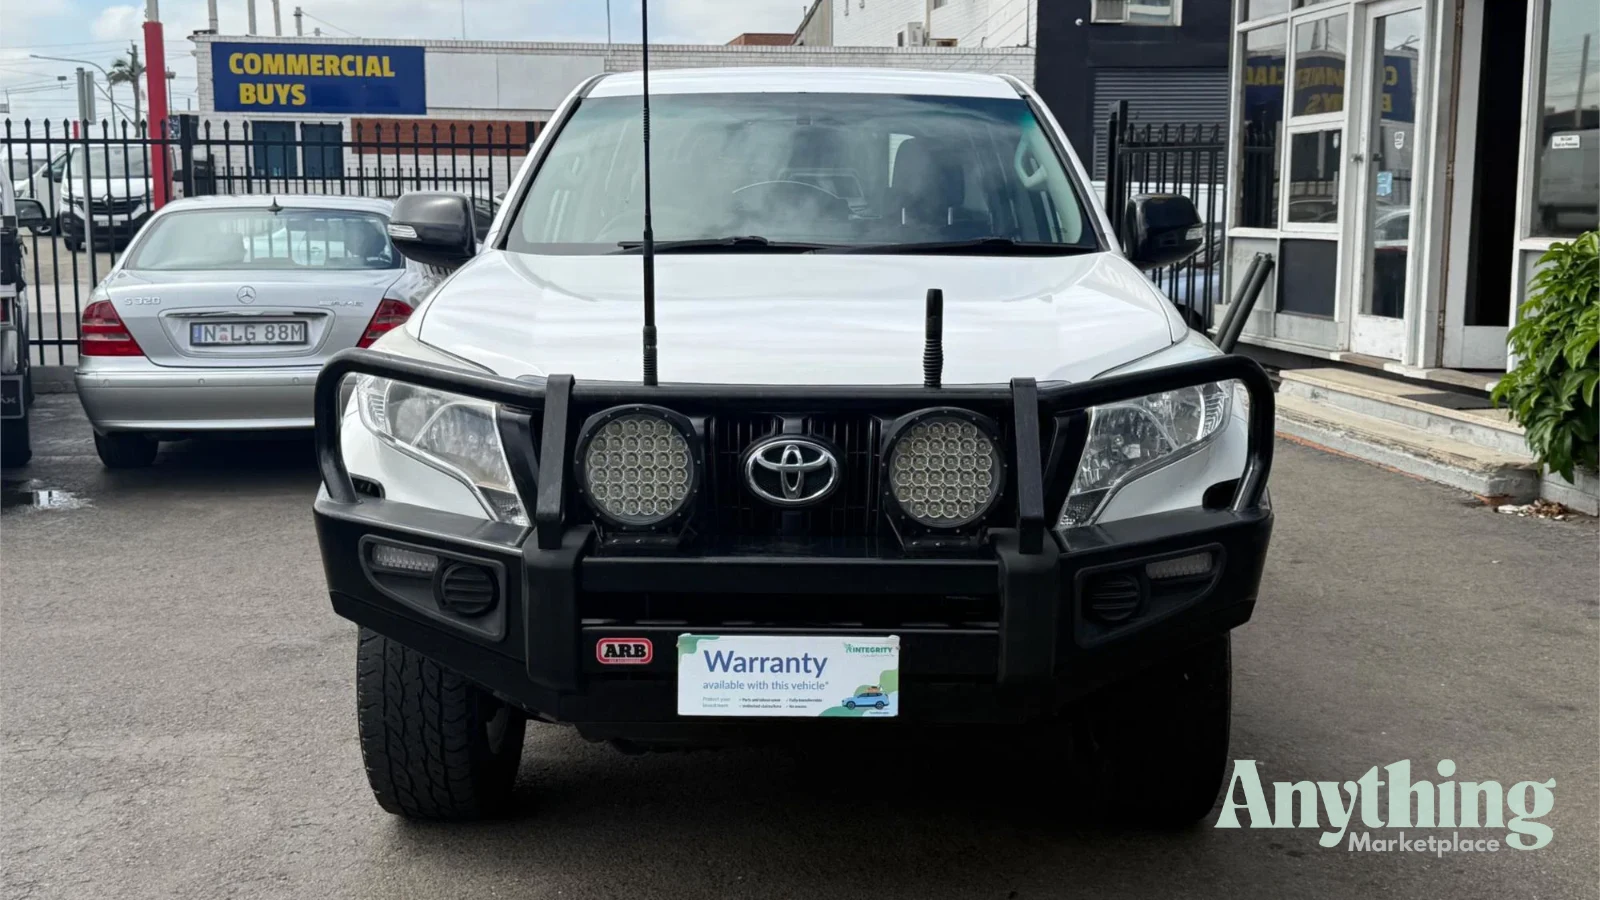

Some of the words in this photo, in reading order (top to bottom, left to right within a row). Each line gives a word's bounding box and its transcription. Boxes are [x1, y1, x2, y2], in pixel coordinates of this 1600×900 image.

[229, 53, 395, 77] COMMERCIAL
[239, 83, 306, 105] BUYS
[124, 296, 133, 306] S
[135, 296, 161, 306] 320
[264, 324, 303, 341] 88M
[604, 643, 647, 658] ARB
[703, 649, 828, 678] Warranty
[702, 681, 745, 690] available
[747, 681, 769, 690] with
[771, 681, 788, 690] this
